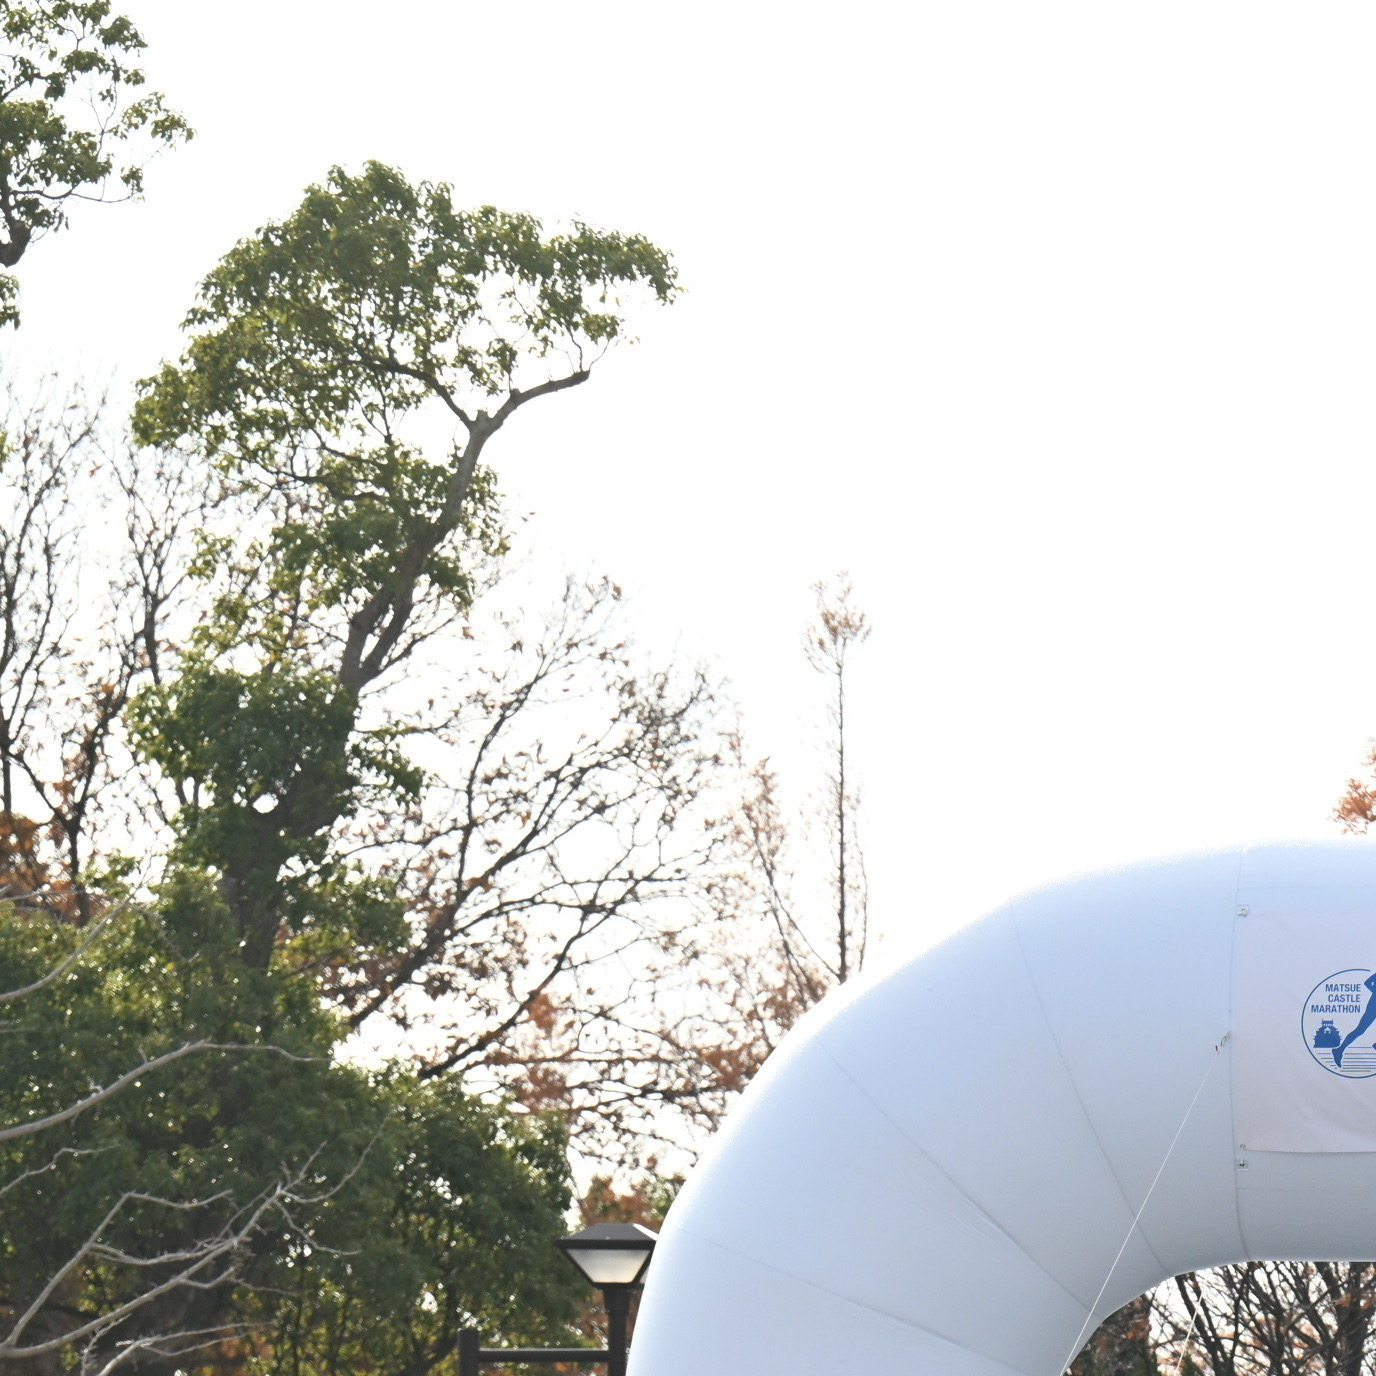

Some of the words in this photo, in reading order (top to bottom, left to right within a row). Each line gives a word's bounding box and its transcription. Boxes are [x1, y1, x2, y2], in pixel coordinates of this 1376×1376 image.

[1325, 984, 1361, 992] MATSUE
[1328, 994, 1361, 1002] CASTLE
[1311, 1004, 1360, 1013] MARATHON
